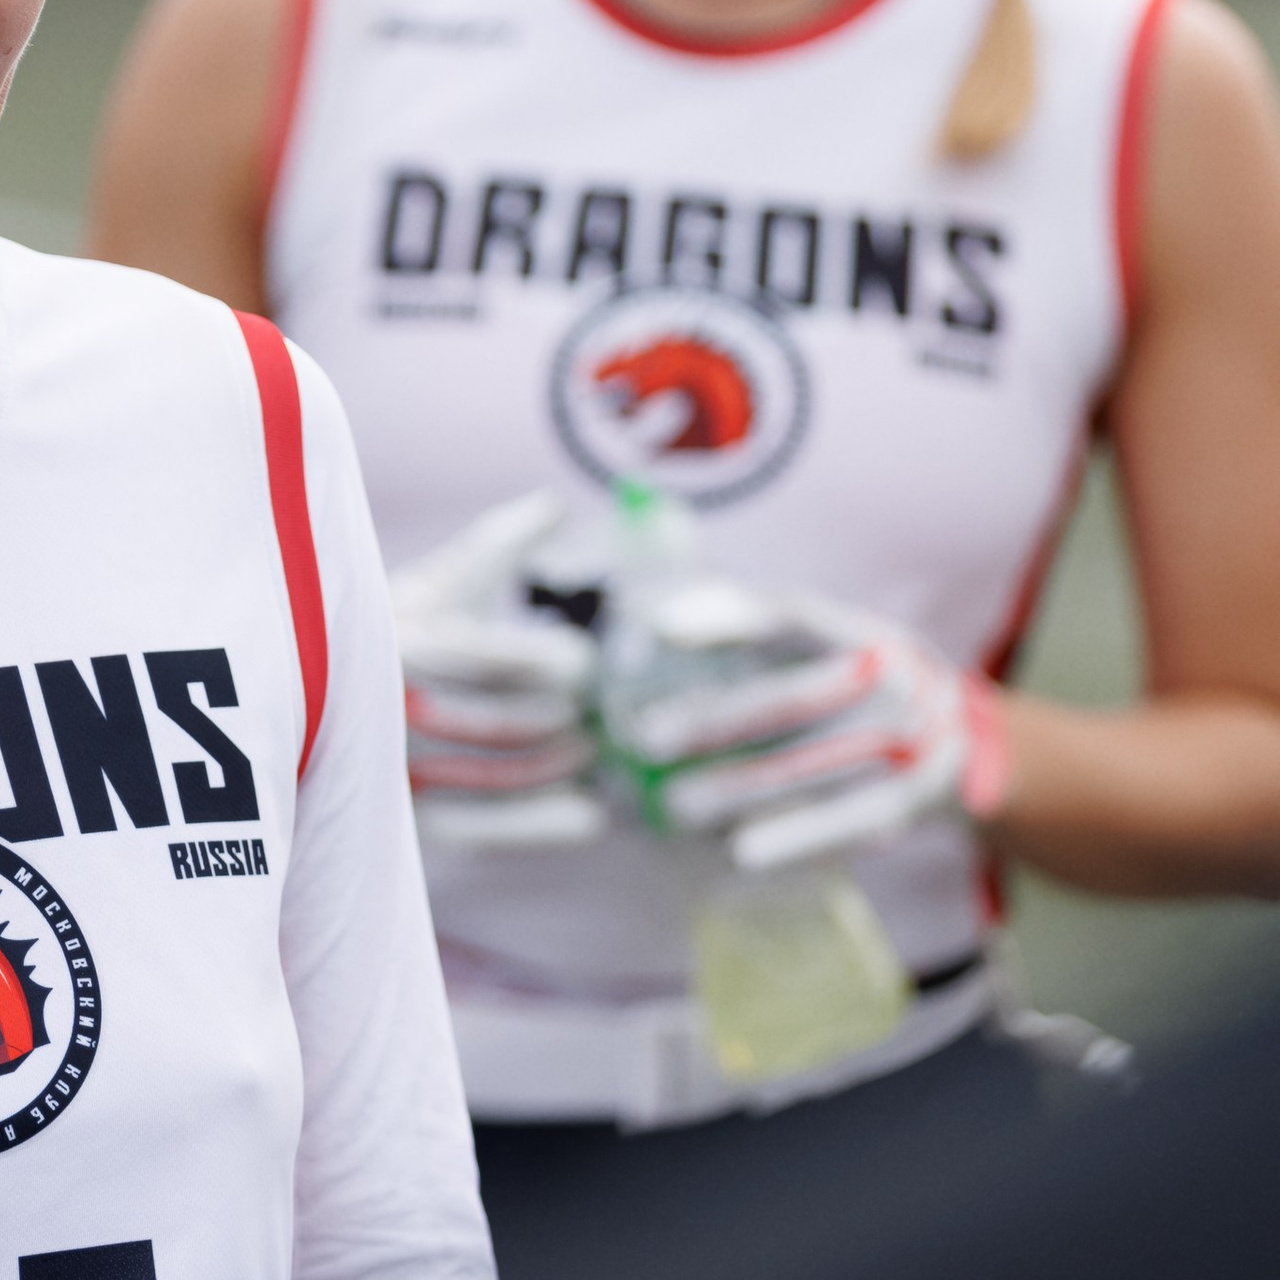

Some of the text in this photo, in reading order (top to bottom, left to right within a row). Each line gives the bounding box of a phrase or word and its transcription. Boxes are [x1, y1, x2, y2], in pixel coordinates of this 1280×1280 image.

[380, 169, 1008, 337] DRAGONS
[167, 838, 270, 880] RUSSIA
[13, 866, 97, 1049] МОСКОВСКИЙ
[29, 1063, 82, 1125] КЛУБ
